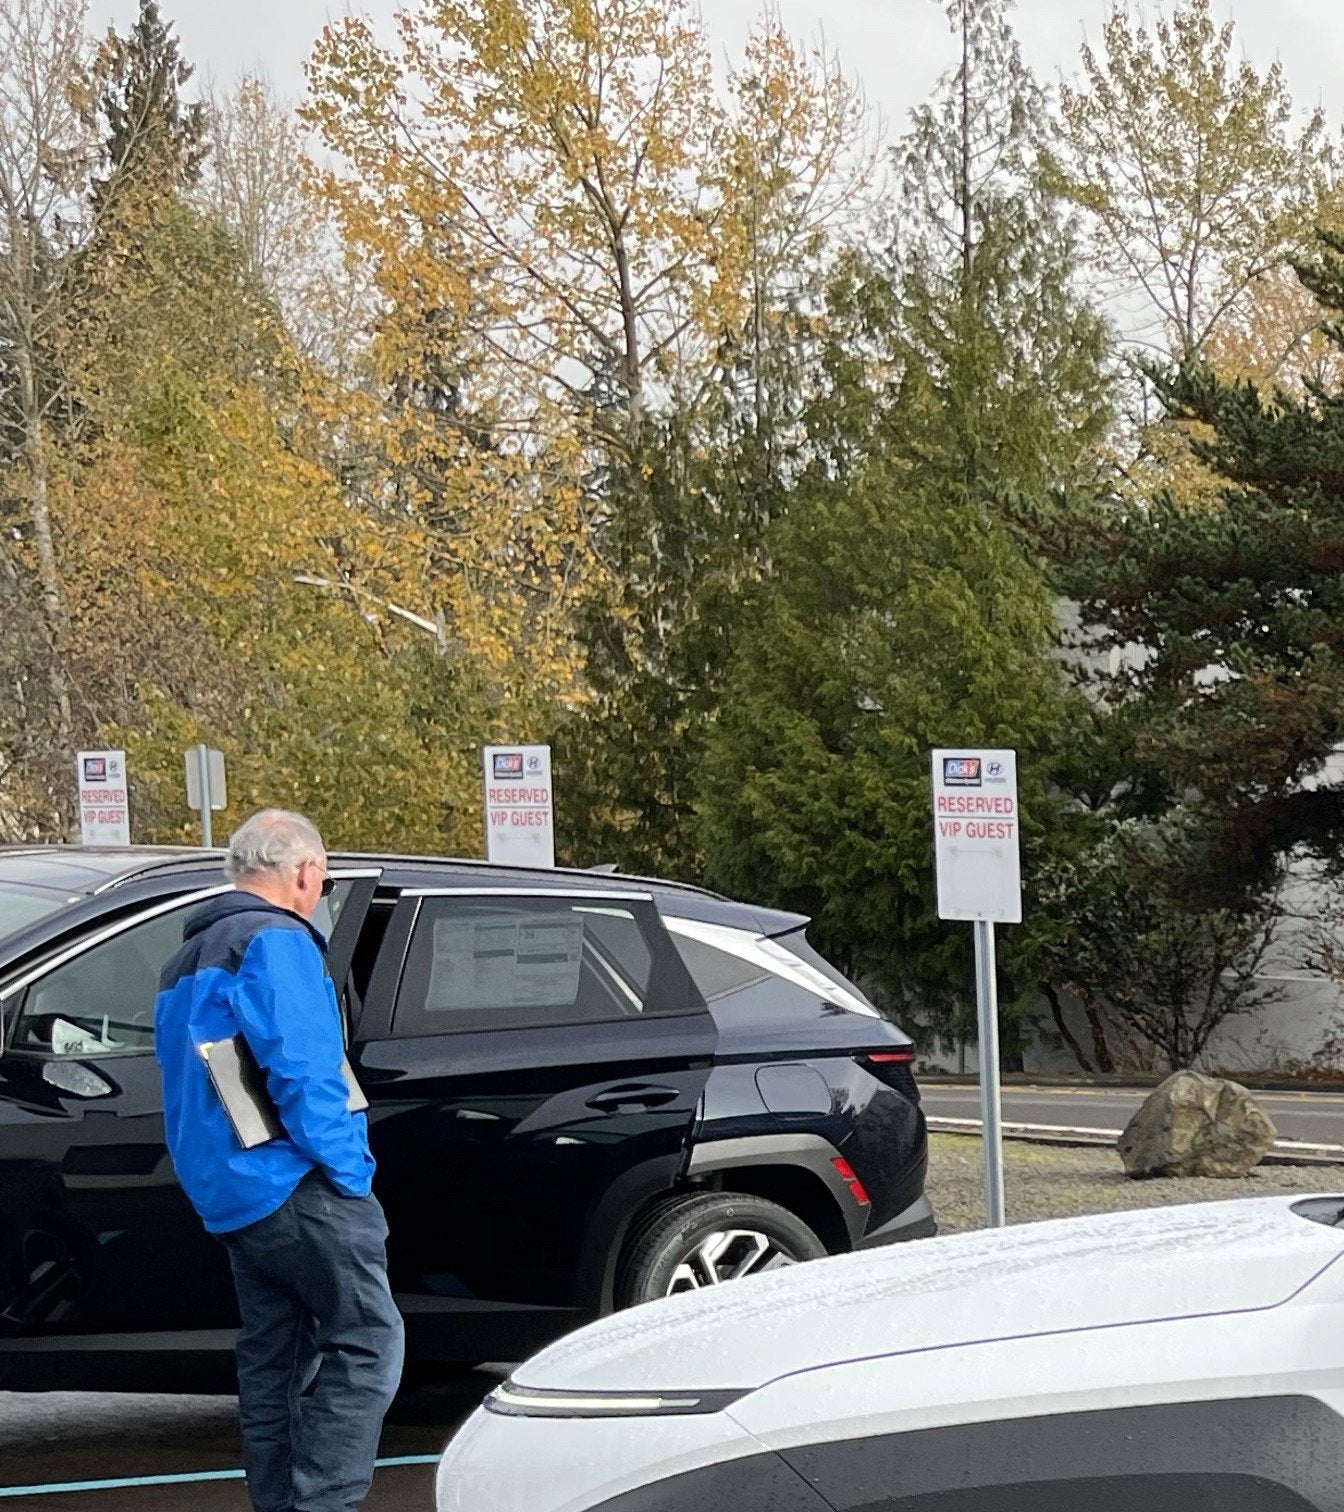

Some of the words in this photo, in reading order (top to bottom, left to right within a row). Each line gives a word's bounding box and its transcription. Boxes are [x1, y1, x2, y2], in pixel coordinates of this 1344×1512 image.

[488, 788, 549, 803] RESERVED
[937, 796, 1014, 814] RESERVED
[490, 811, 508, 826] VIP
[511, 811, 549, 826] GUEST
[939, 821, 961, 838] VIP
[966, 822, 1014, 839] GUEST
